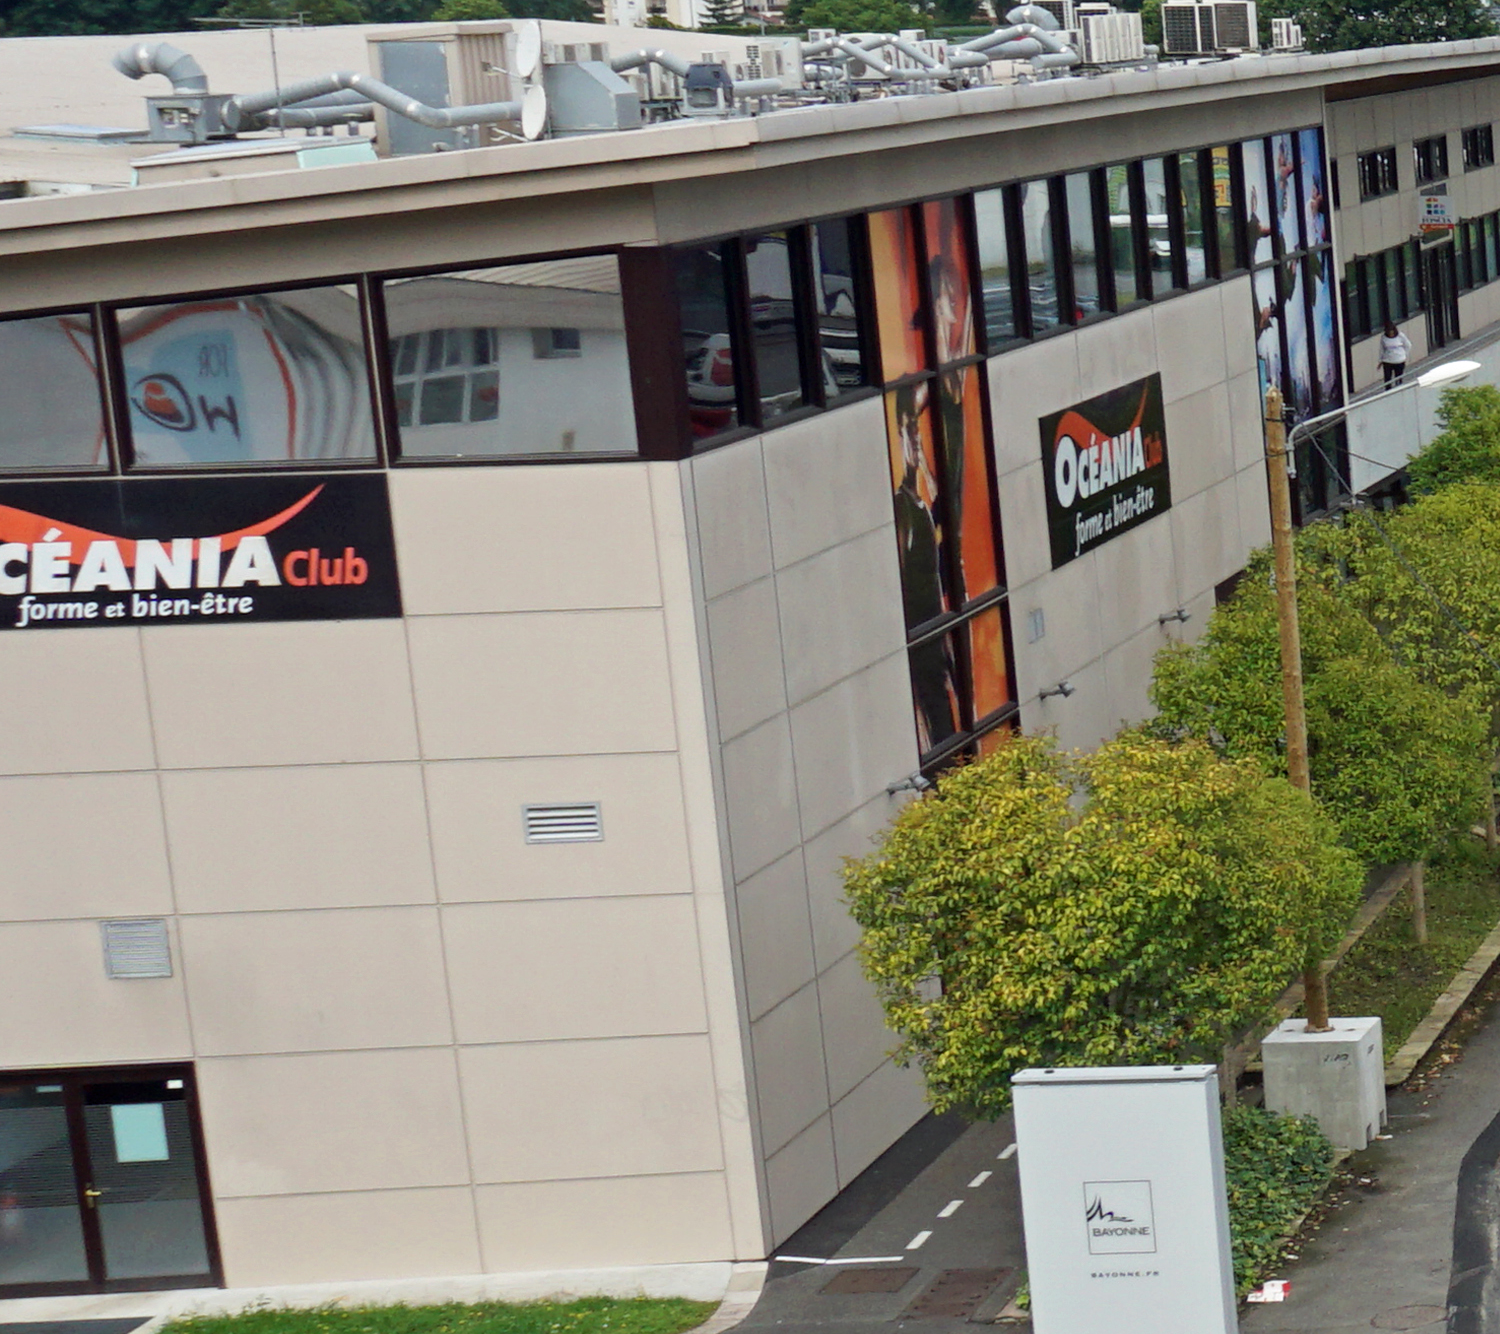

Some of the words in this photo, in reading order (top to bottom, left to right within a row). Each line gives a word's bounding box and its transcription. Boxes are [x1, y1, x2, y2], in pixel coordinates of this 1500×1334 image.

[1055, 426, 1145, 508] OCÉANIA
[1075, 511, 1103, 557] forme
[1104, 509, 1112, 530] et
[1113, 485, 1154, 527] bien-être
[283, 547, 368, 587] Club
[16, 595, 99, 627] forme
[105, 601, 126, 618] et
[132, 592, 253, 617] bien-être
[1092, 1226, 1151, 1237] BAYONNE
